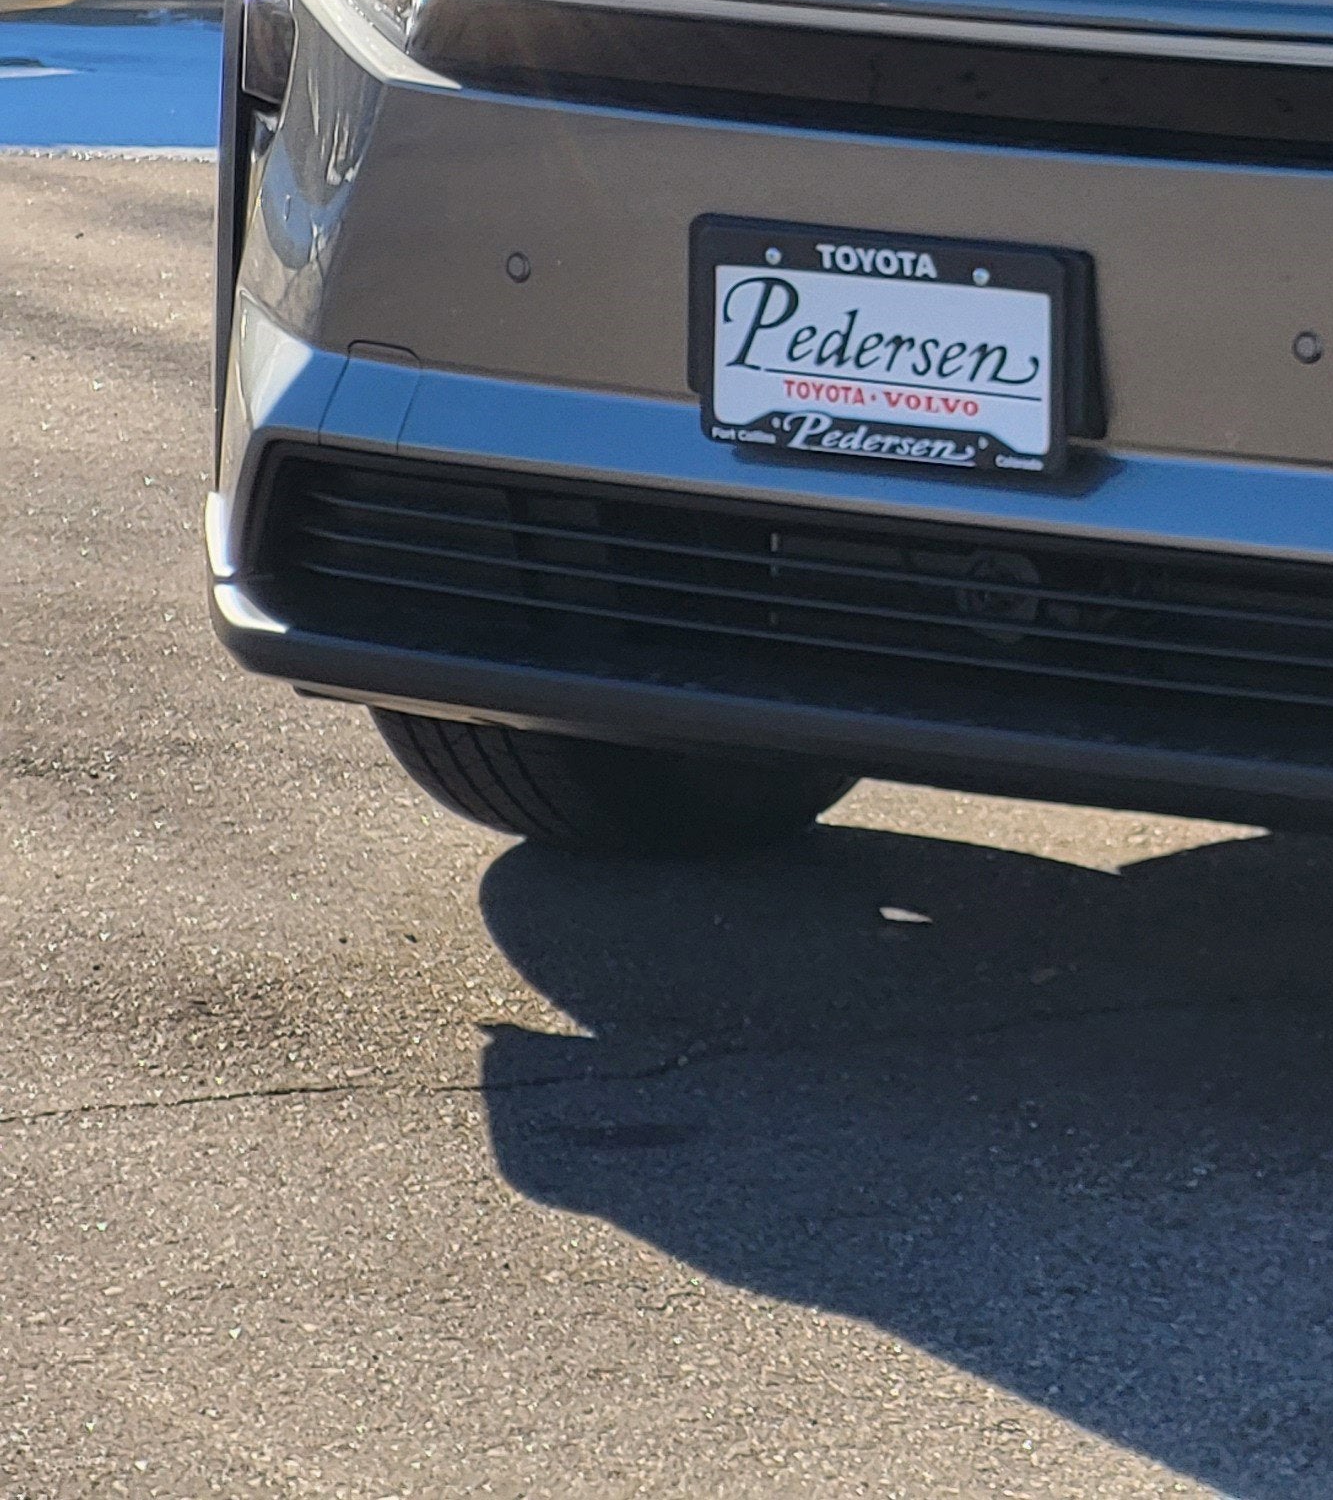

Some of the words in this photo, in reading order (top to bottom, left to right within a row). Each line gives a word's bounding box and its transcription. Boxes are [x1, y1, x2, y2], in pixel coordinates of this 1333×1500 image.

[816, 244, 938, 279] TOYOTA
[722, 276, 1040, 385] Pedersen
[784, 379, 866, 406] TOYOTA
[884, 391, 980, 417] VOLVO
[782, 411, 976, 461] Pedersen
